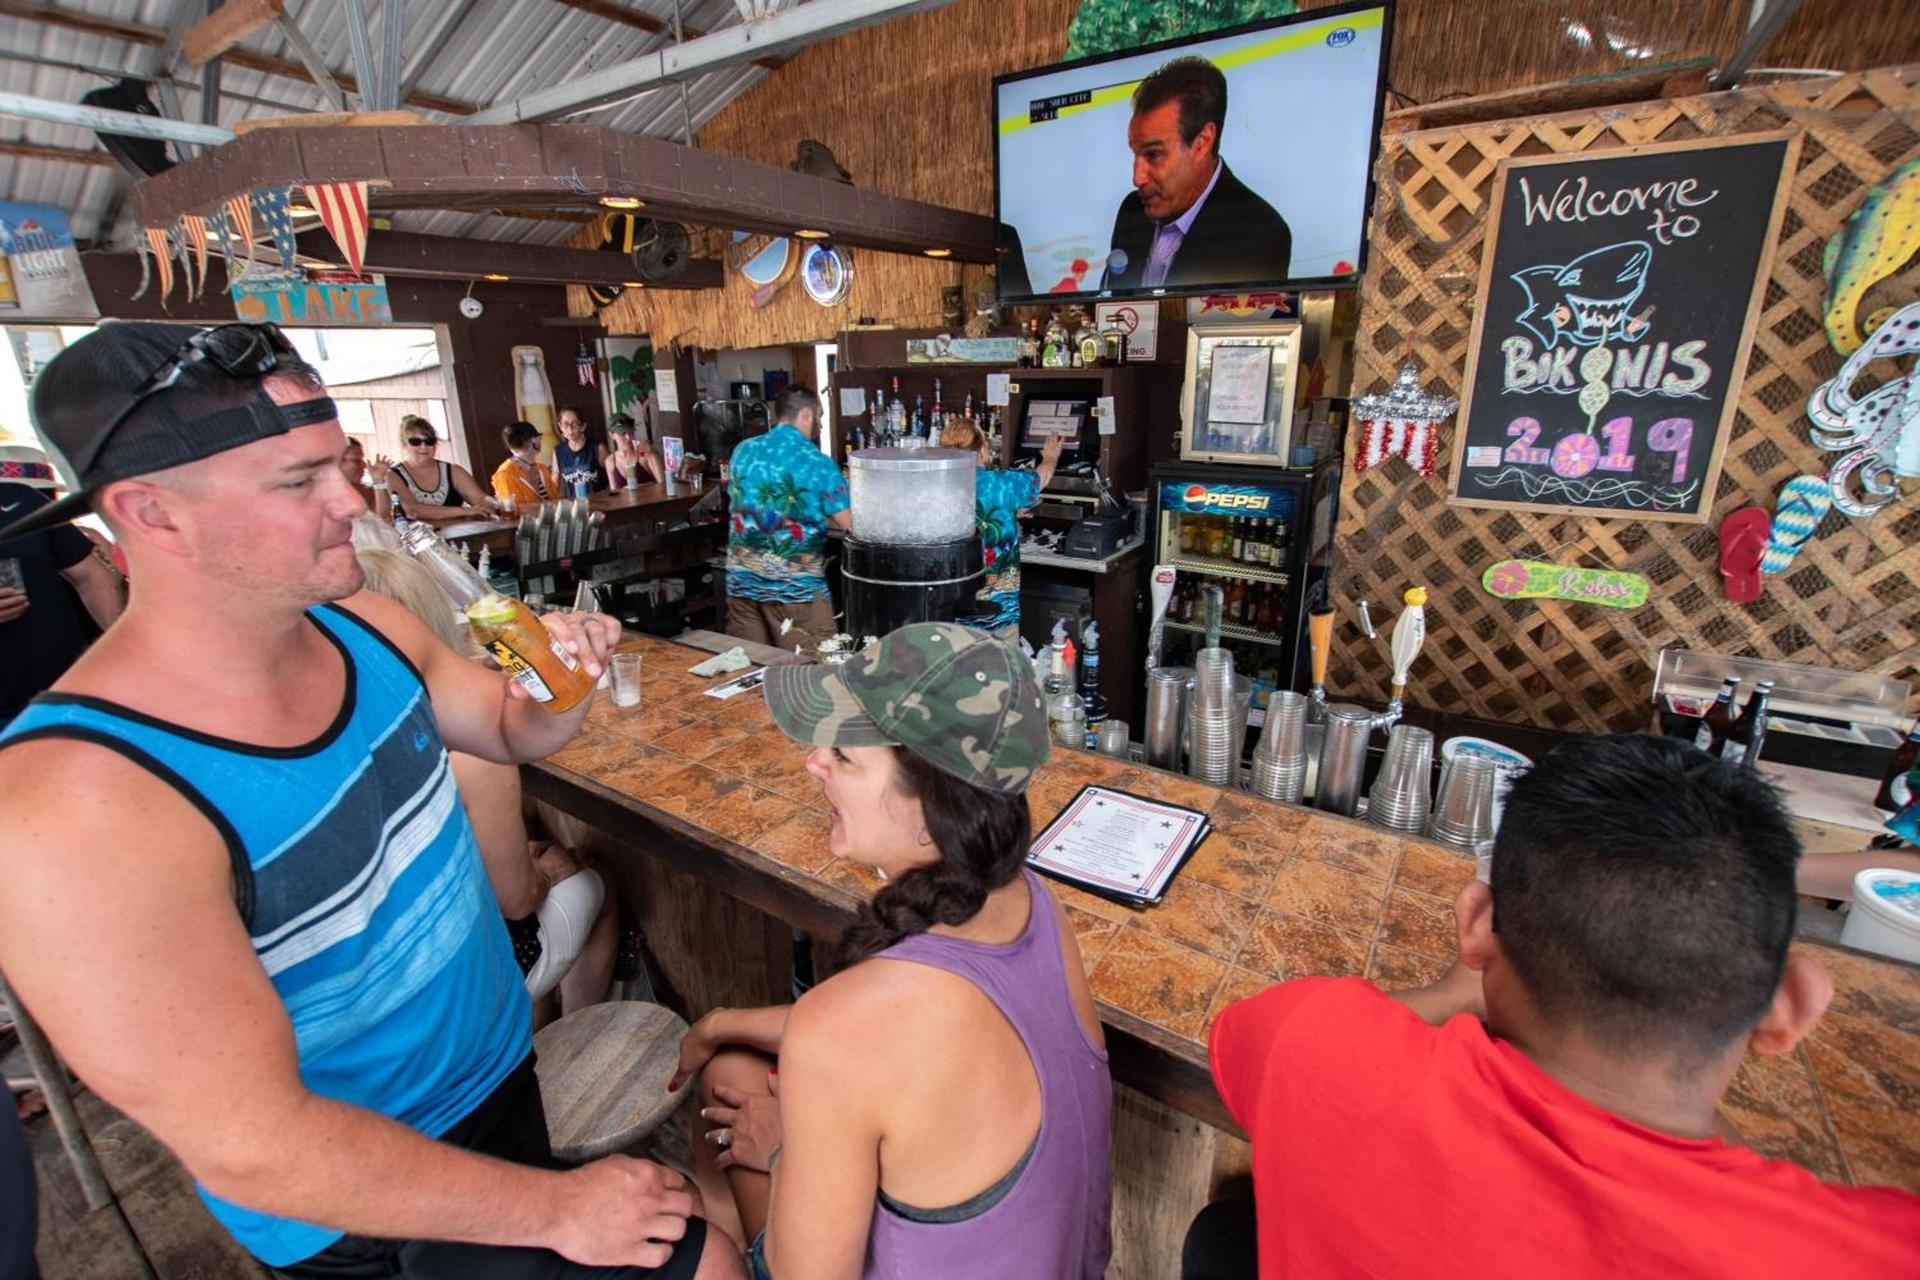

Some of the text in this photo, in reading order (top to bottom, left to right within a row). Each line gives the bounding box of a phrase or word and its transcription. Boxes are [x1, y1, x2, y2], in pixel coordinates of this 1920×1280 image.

[1332, 30, 1350, 42] FOX
[1519, 175, 1720, 226] Welcome
[1647, 208, 1701, 245] to
[16, 250, 65, 272] LIGHT
[276, 287, 380, 322] LAKE
[1503, 416, 1695, 484] 2019
[1204, 492, 1271, 510] PEPSI
[1558, 572, 1632, 597] Relax
